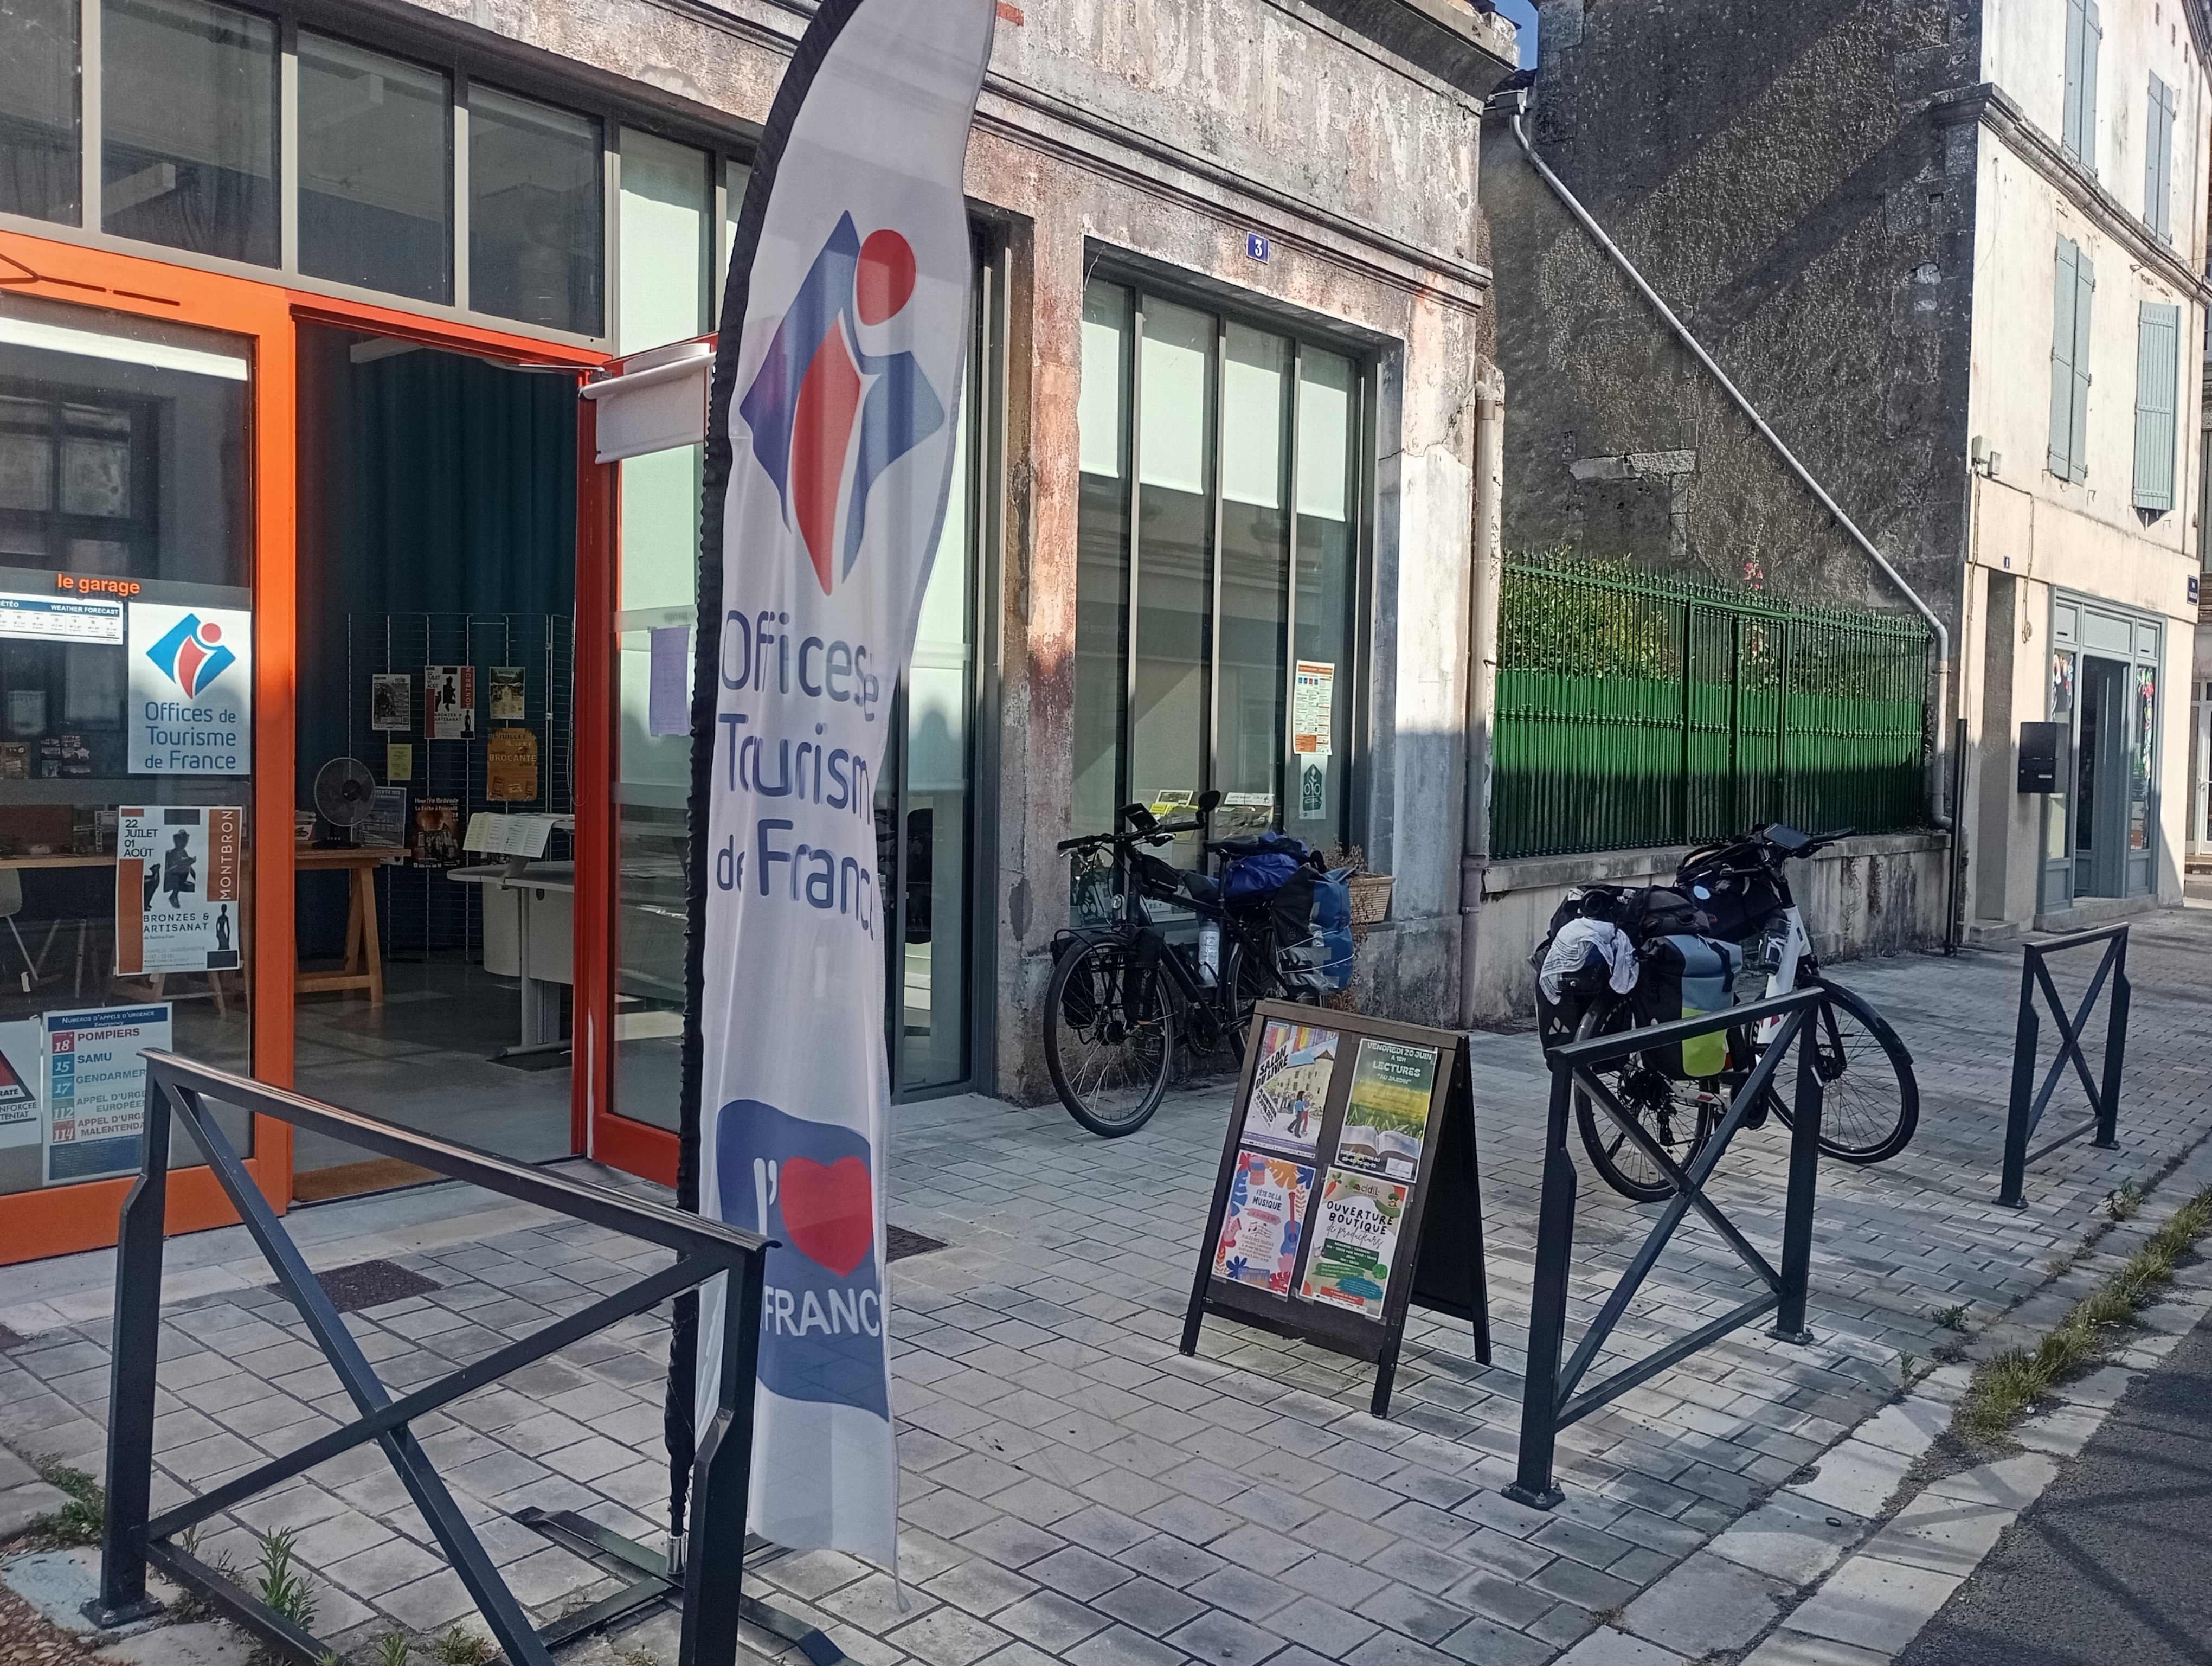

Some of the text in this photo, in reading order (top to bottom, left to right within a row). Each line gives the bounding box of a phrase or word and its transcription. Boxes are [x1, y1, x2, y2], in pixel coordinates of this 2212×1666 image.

[1255, 239, 1263, 257] 3
[57, 574, 140, 597] le garage
[84, 607, 119, 615] FORECAST
[145, 702, 236, 723] Offices de
[146, 726, 236, 747] Tourisme
[145, 751, 236, 770] de France
[489, 754, 537, 762] BROCANTE
[125, 819, 138, 828] 22
[124, 829, 158, 838] JUILET
[124, 839, 135, 848] 01
[124, 847, 154, 857] AOÛT
[220, 811, 233, 900] MONTBRON
[757, 819, 874, 941] Franc
[143, 913, 196, 922] BRONZES
[143, 922, 209, 933] ARTISANAT
[54, 1028, 140, 1052] 18 POMPIERS
[1259, 1045, 1287, 1077] SALON
[1367, 1042, 1432, 1061] VENDREDI 20 JUIN
[55, 1052, 112, 1072] 15 SAMU
[1372, 1060, 1421, 1077] LECTURES
[1255, 1053, 1289, 1091] DU LIVRE
[55, 1083, 71, 1095] 17
[77, 1094, 108, 1105] APPEL
[54, 1099, 145, 1120] 112 EUROPÉE
[54, 1128, 74, 1142] 114
[78, 1117, 108, 1127] APPEL
[1252, 1196, 1282, 1212] MUSIQUE
[1256, 1188, 1281, 1201] FÊTE DE LA
[1327, 1201, 1394, 1226] OUVERTURE
[1329, 1212, 1387, 1235] BOUTIQUE
[1335, 1226, 1384, 1249] producteurs
[765, 1284, 881, 1337] FRANC
